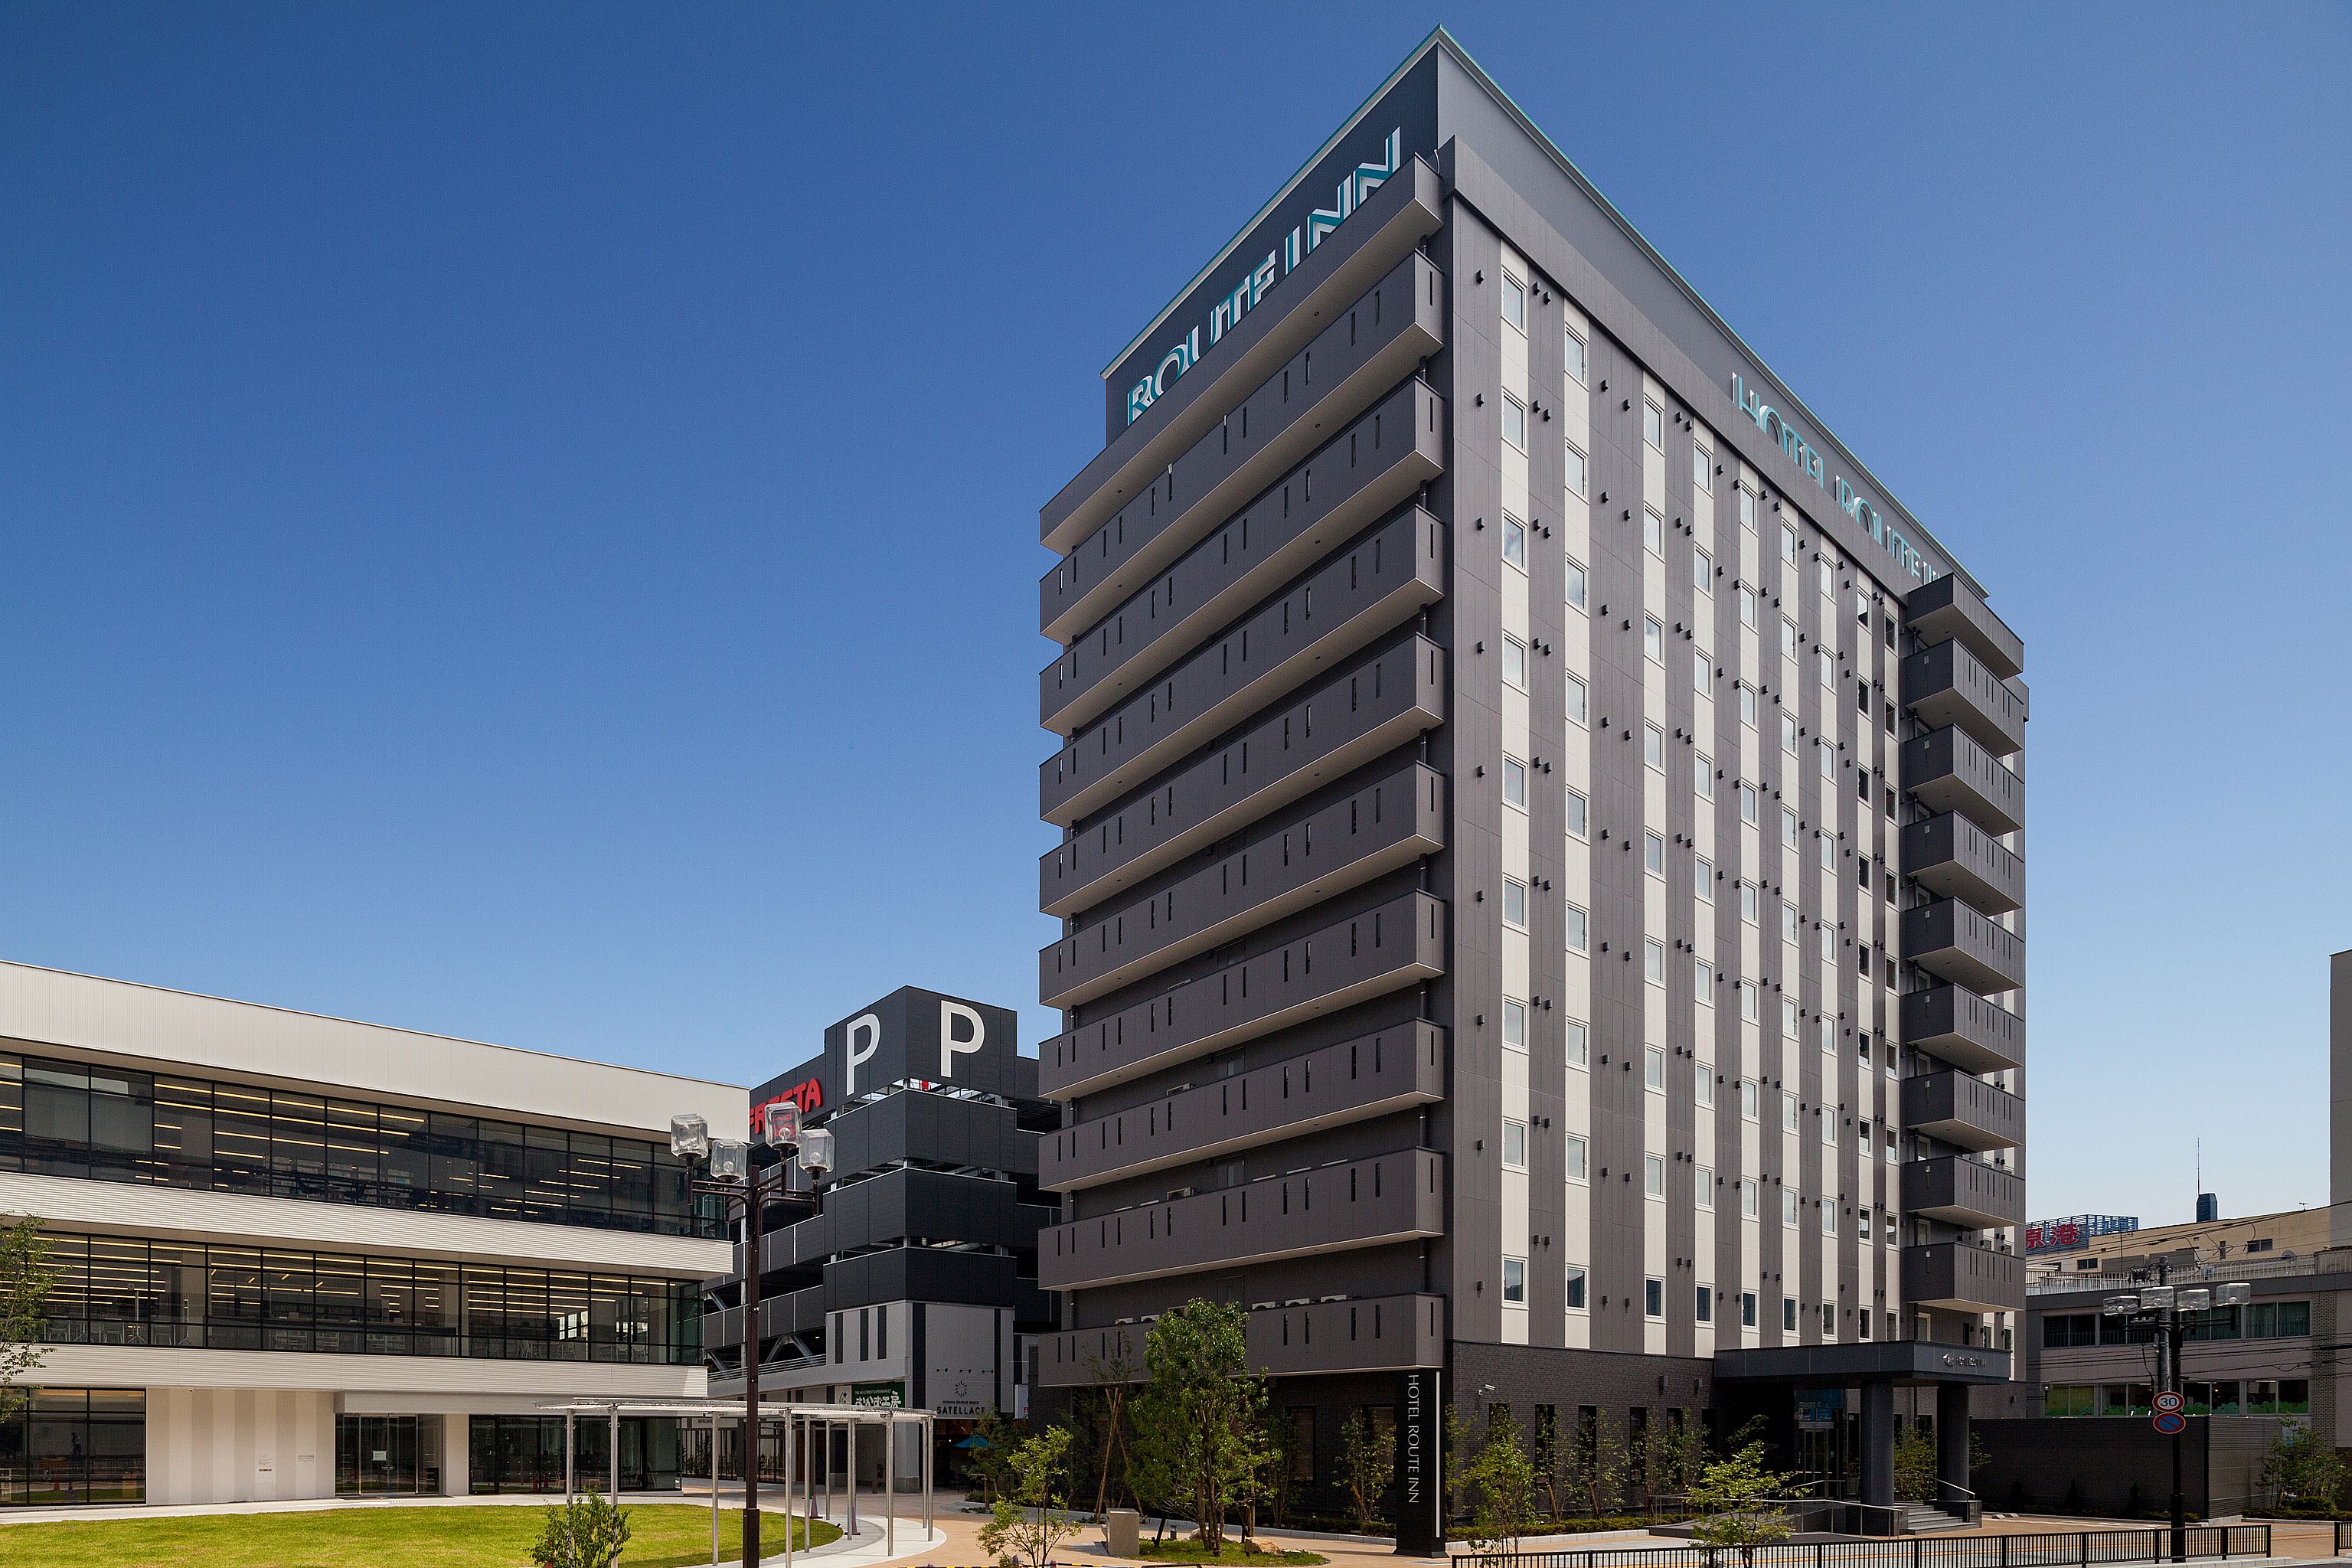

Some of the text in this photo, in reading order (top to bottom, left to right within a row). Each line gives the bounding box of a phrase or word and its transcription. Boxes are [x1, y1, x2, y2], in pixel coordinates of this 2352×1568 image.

[1285, 126, 1400, 275] INN
[846, 1013, 880, 1096] P
[940, 1000, 985, 1078] P
[1407, 1374, 1419, 1503] HOTEL ROUTE INN
[2160, 1397, 2177, 1407] 30
